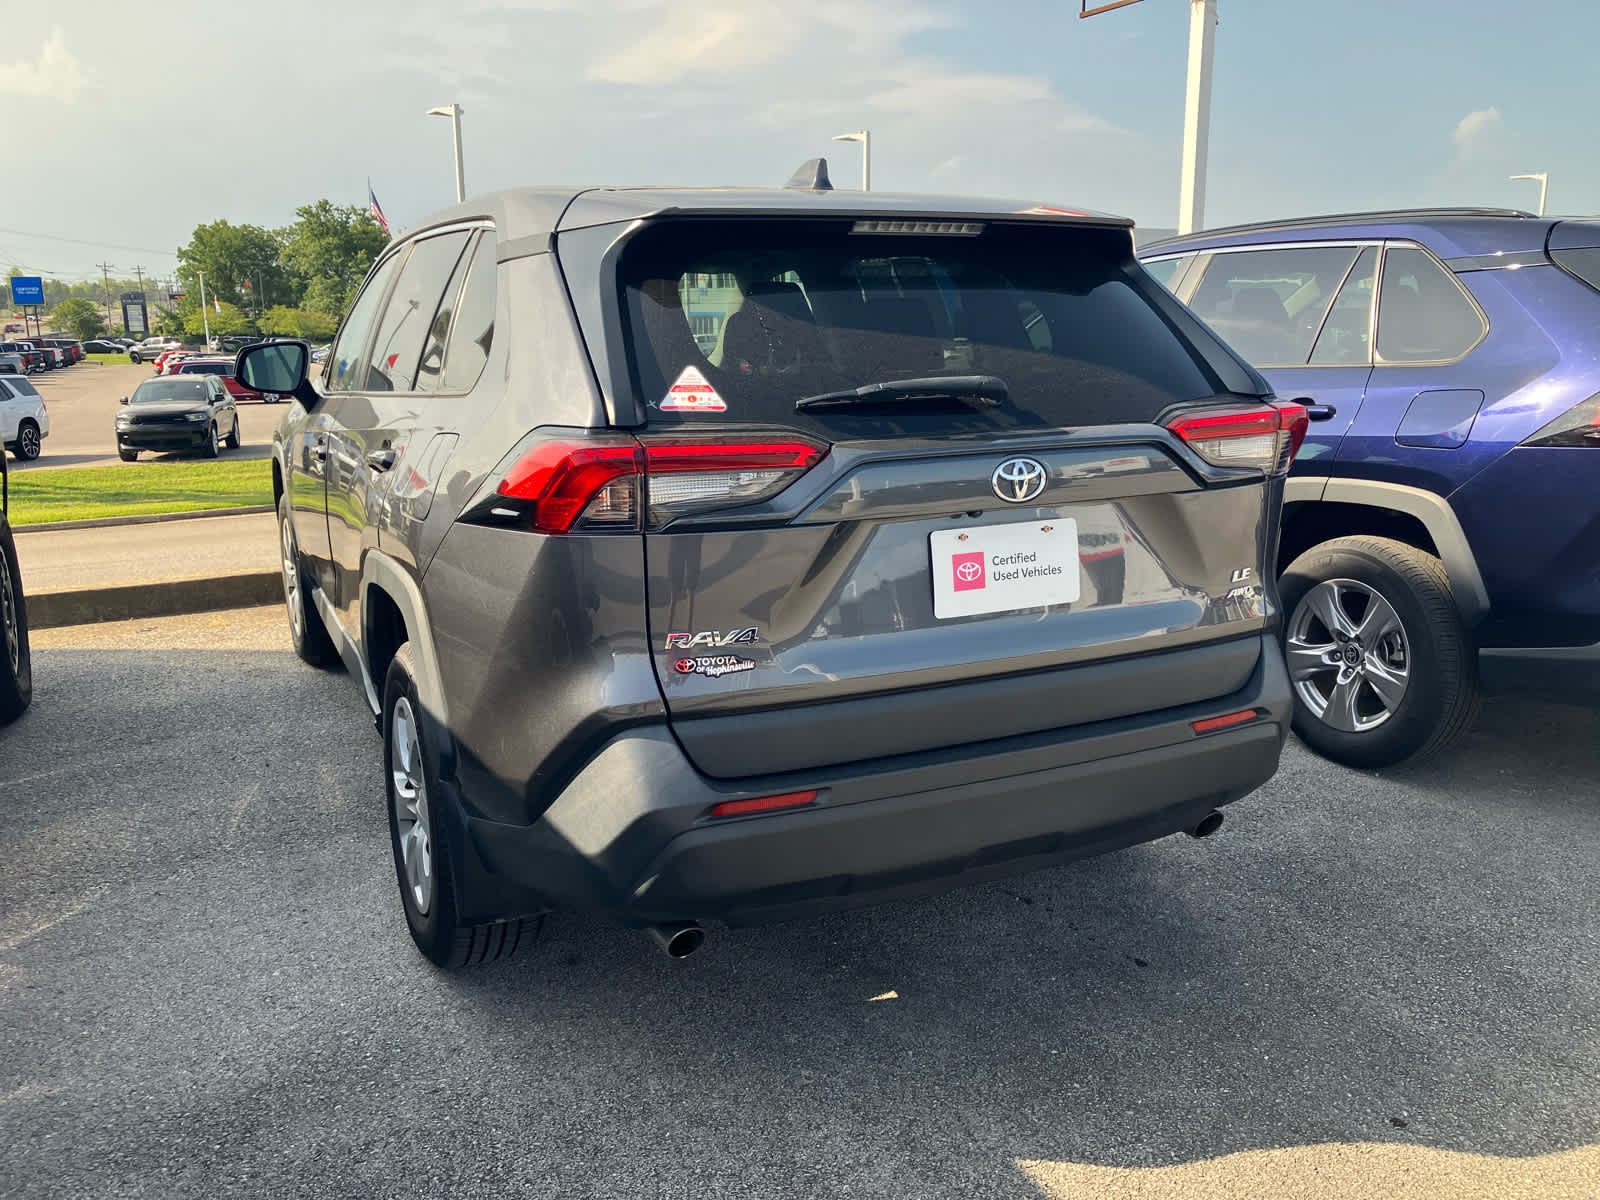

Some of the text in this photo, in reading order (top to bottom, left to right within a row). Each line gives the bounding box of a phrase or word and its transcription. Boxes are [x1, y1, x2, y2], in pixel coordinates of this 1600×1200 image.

[992, 552, 1036, 566] Certified
[993, 564, 1062, 582] Used Vehicles
[1230, 567, 1251, 583] LE
[664, 626, 759, 649] RAV4
[695, 656, 737, 666] TOYOTA
[705, 660, 755, 676] Hopkinsville
